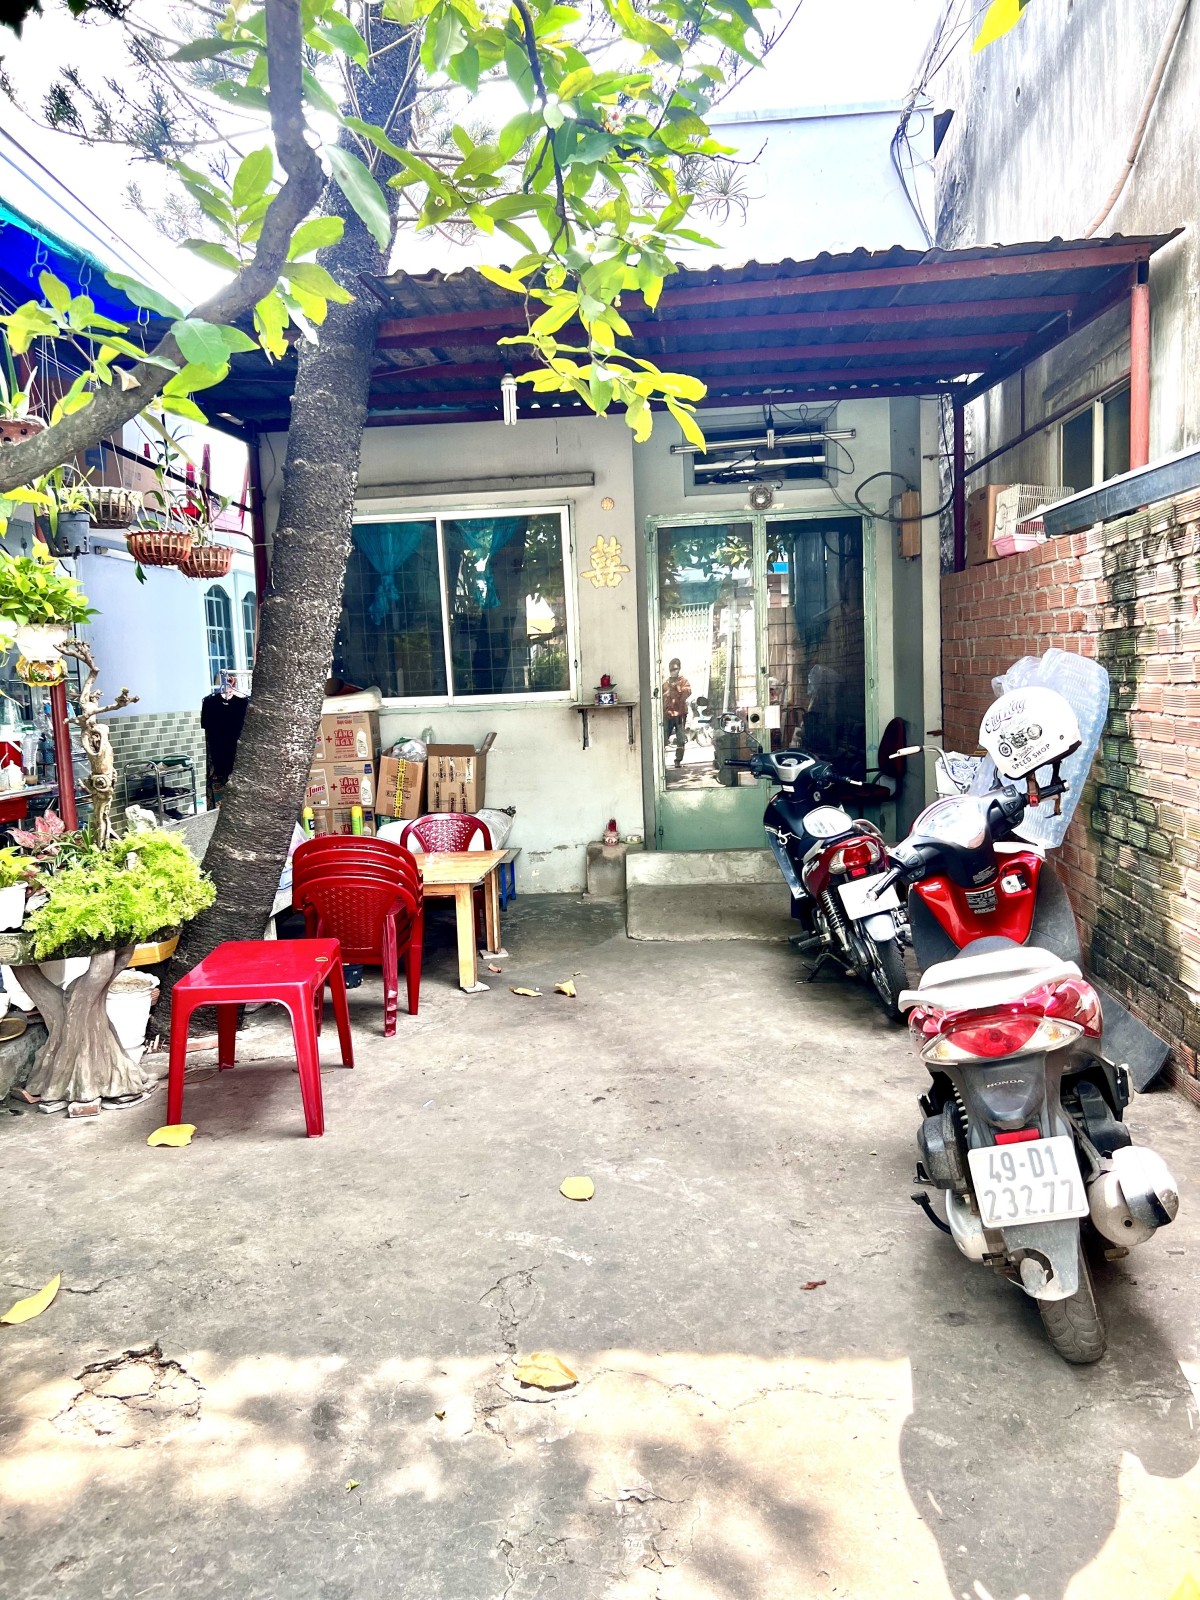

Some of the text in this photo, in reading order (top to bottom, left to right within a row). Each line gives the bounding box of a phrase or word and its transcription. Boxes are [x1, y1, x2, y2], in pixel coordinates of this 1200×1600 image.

[335, 738, 354, 746] NGAY
[1012, 757, 1032, 770] SPEED
[1032, 743, 1050, 758] SHOP
[341, 785, 360, 794] NGAY
[987, 1079, 1024, 1089] HONDA
[984, 1180, 1075, 1221] 232.77
